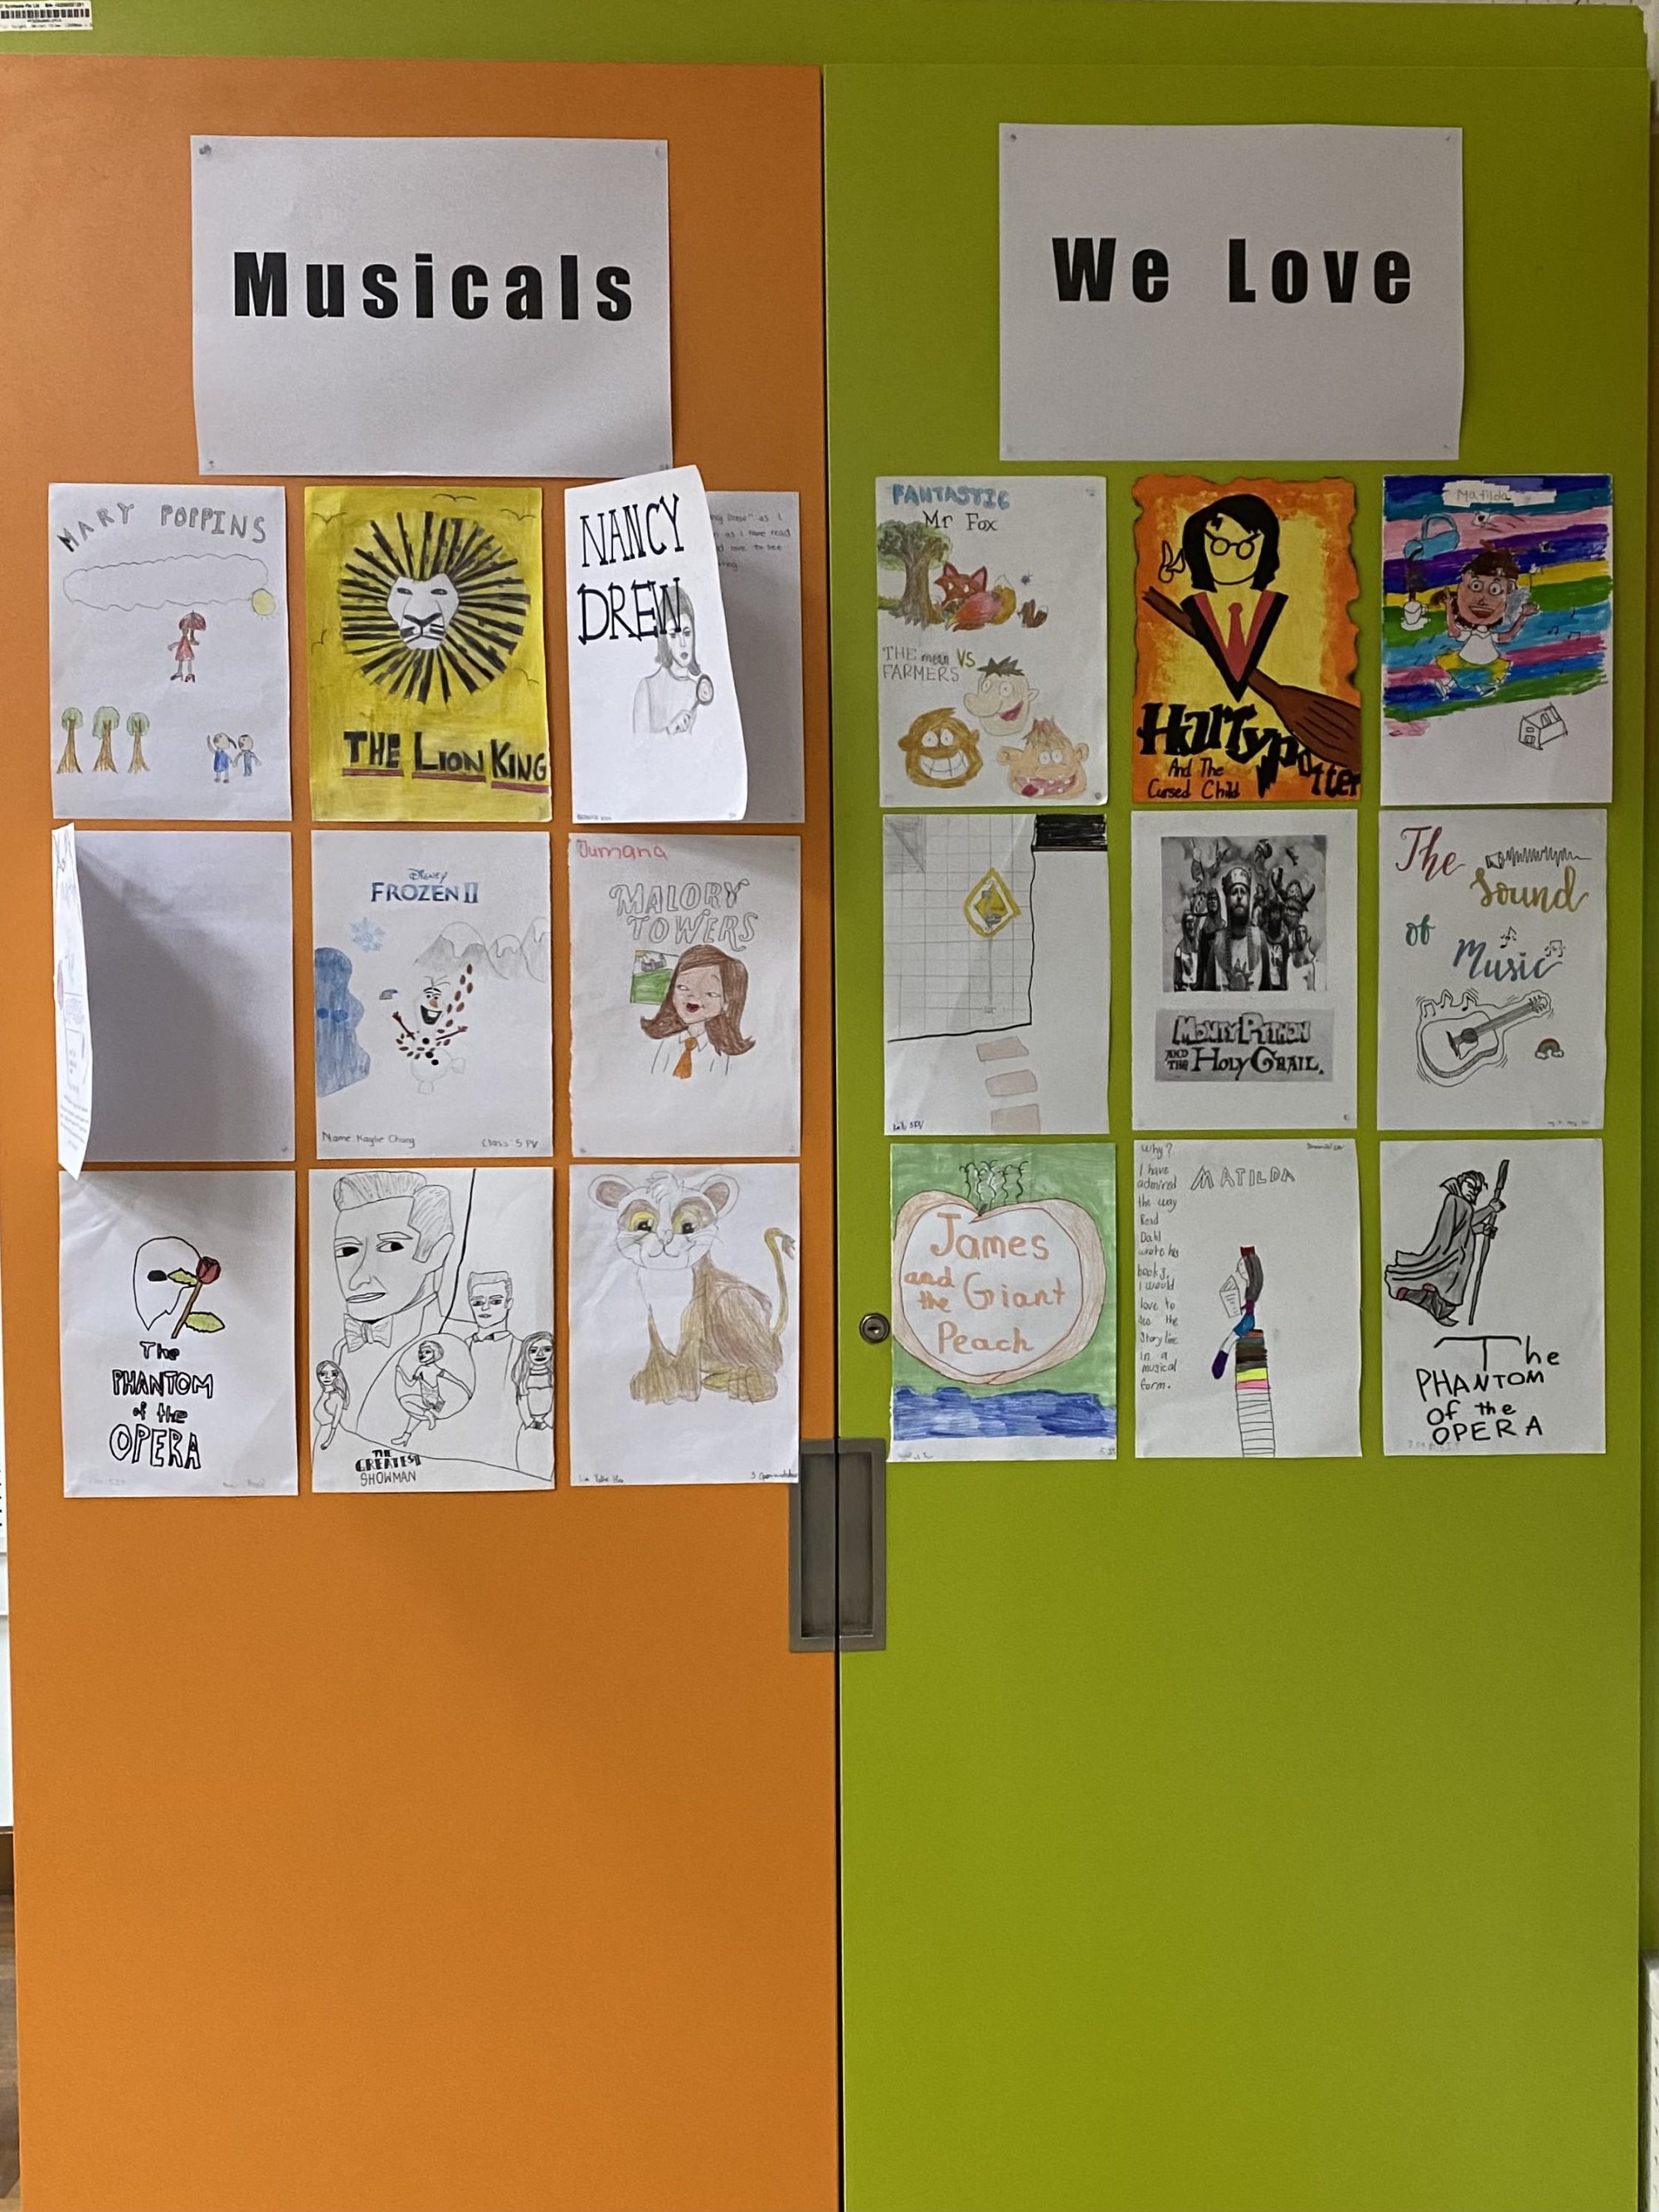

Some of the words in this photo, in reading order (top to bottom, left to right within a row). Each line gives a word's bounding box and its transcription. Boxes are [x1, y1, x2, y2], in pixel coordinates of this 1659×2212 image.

[1052, 237, 1169, 303] We
[1228, 238, 1411, 304] Love
[234, 251, 632, 321] Musicals
[893, 483, 1010, 510] FANTASTIC
[1457, 490, 1511, 502] Matilda
[56, 502, 134, 553] MARY
[161, 504, 266, 543] POPPINS
[580, 493, 684, 568] NANCY
[922, 509, 954, 529] Mr
[966, 512, 999, 531] Fox
[577, 577, 681, 646] DREW
[883, 646, 917, 661] THE
[922, 653, 949, 665] mean
[957, 648, 975, 668] VS
[883, 664, 960, 682] FARMERS
[343, 731, 401, 767] THE
[1168, 758, 1193, 777] And
[1200, 758, 1224, 777] The
[1147, 778, 1191, 799] Cursed
[1201, 779, 1241, 800] Child
[577, 840, 669, 860] Jumana
[1395, 826, 1466, 882] The
[371, 882, 459, 903] FROZEN
[609, 879, 750, 917] MALORY
[626, 909, 758, 952] TOWERS
[1405, 914, 1436, 946] of
[1452, 938, 1563, 982] Music
[322, 1131, 351, 1143] Name
[1148, 1163, 1169, 1176] have
[1190, 1165, 1295, 1191] MATILDA
[1137, 1175, 1176, 1190] admired
[1138, 1194, 1151, 1207] the
[1158, 1199, 1177, 1212] way
[930, 1213, 1049, 1260] James
[904, 1265, 955, 1288] and
[917, 1290, 951, 1313] the
[964, 1272, 1065, 1310] Giant
[1141, 1297, 1158, 1311] love
[1165, 1297, 1175, 1310] to
[937, 1321, 1034, 1354] Peach
[139, 1341, 180, 1361] The
[1161, 1352, 1168, 1360] a
[1433, 1335, 1560, 1372] The
[1141, 1358, 1177, 1373] musical
[111, 1369, 214, 1400] PHANTOM
[1416, 1368, 1545, 1402] PHANTOM
[133, 1401, 148, 1420] of
[157, 1402, 188, 1424] the
[1475, 1401, 1516, 1416] the
[1432, 1415, 1543, 1445] OPERA
[109, 1424, 202, 1470] OPERA
[355, 1454, 421, 1473] GREATEST
[360, 1471, 416, 1487] SHOWMAN
